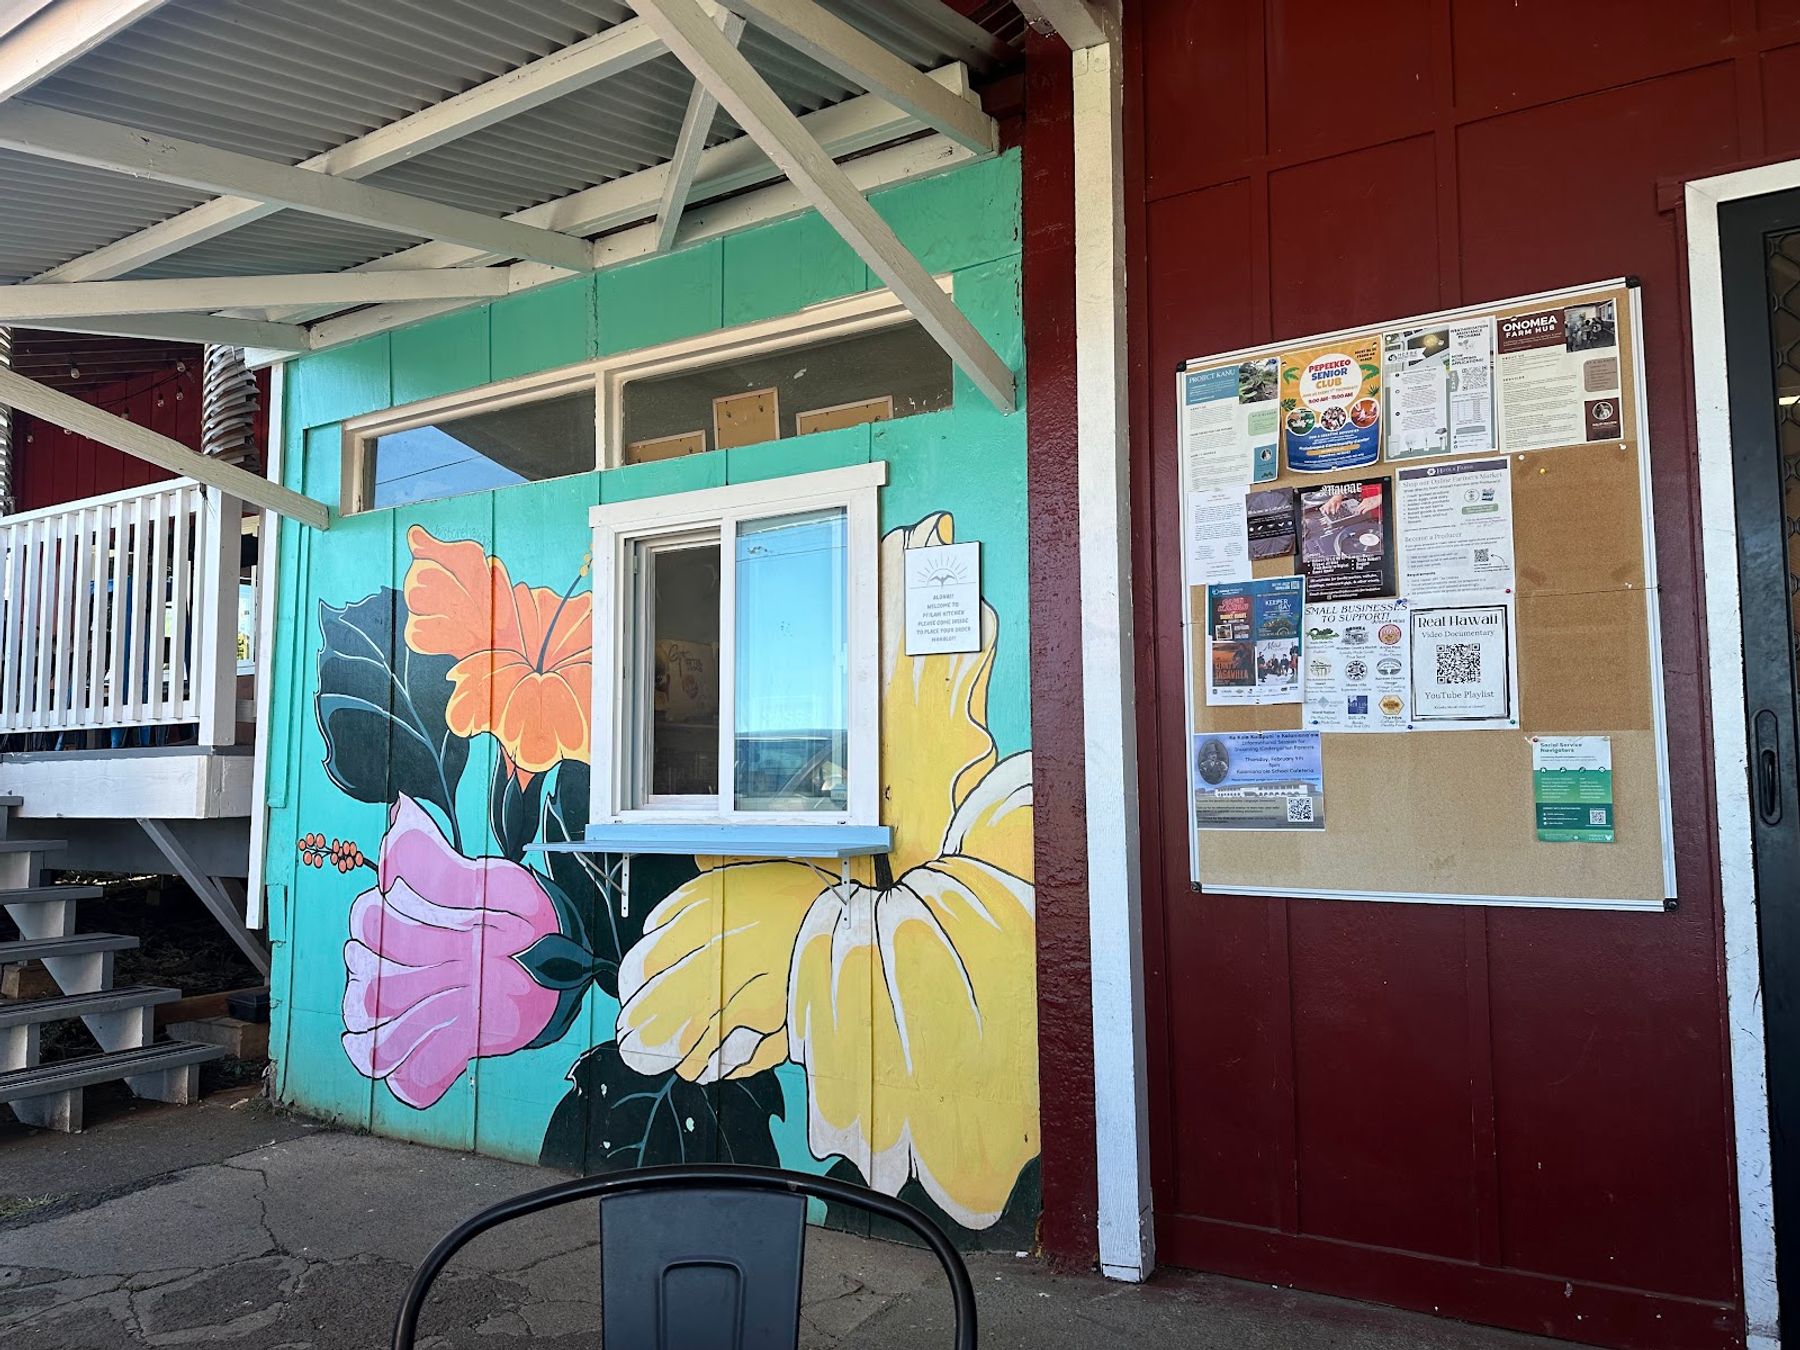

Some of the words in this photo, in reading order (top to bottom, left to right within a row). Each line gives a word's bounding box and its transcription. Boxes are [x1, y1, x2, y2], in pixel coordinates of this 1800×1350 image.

[1502, 315, 1558, 332] ONOMEA
[1505, 329, 1532, 339] FARM
[1535, 324, 1555, 333] HUB
[1309, 359, 1351, 373] PEPEEKEO
[1189, 372, 1215, 384] PROJECT
[1216, 369, 1236, 379] KANU
[1311, 367, 1348, 381] SENIOR
[1315, 377, 1342, 389] CLUB
[943, 609, 965, 617] KITCHEN
[1305, 606, 1337, 616] SMALL
[1341, 602, 1408, 614] BUSINESSES
[1322, 615, 1336, 623] TO
[1339, 612, 1390, 622] SUPPORT!
[1418, 616, 1446, 628] Real
[1449, 613, 1498, 626] Hawaii
[1444, 629, 1495, 638] Documentary
[1425, 691, 1462, 700] YouTube
[1464, 689, 1495, 699] Playlist
